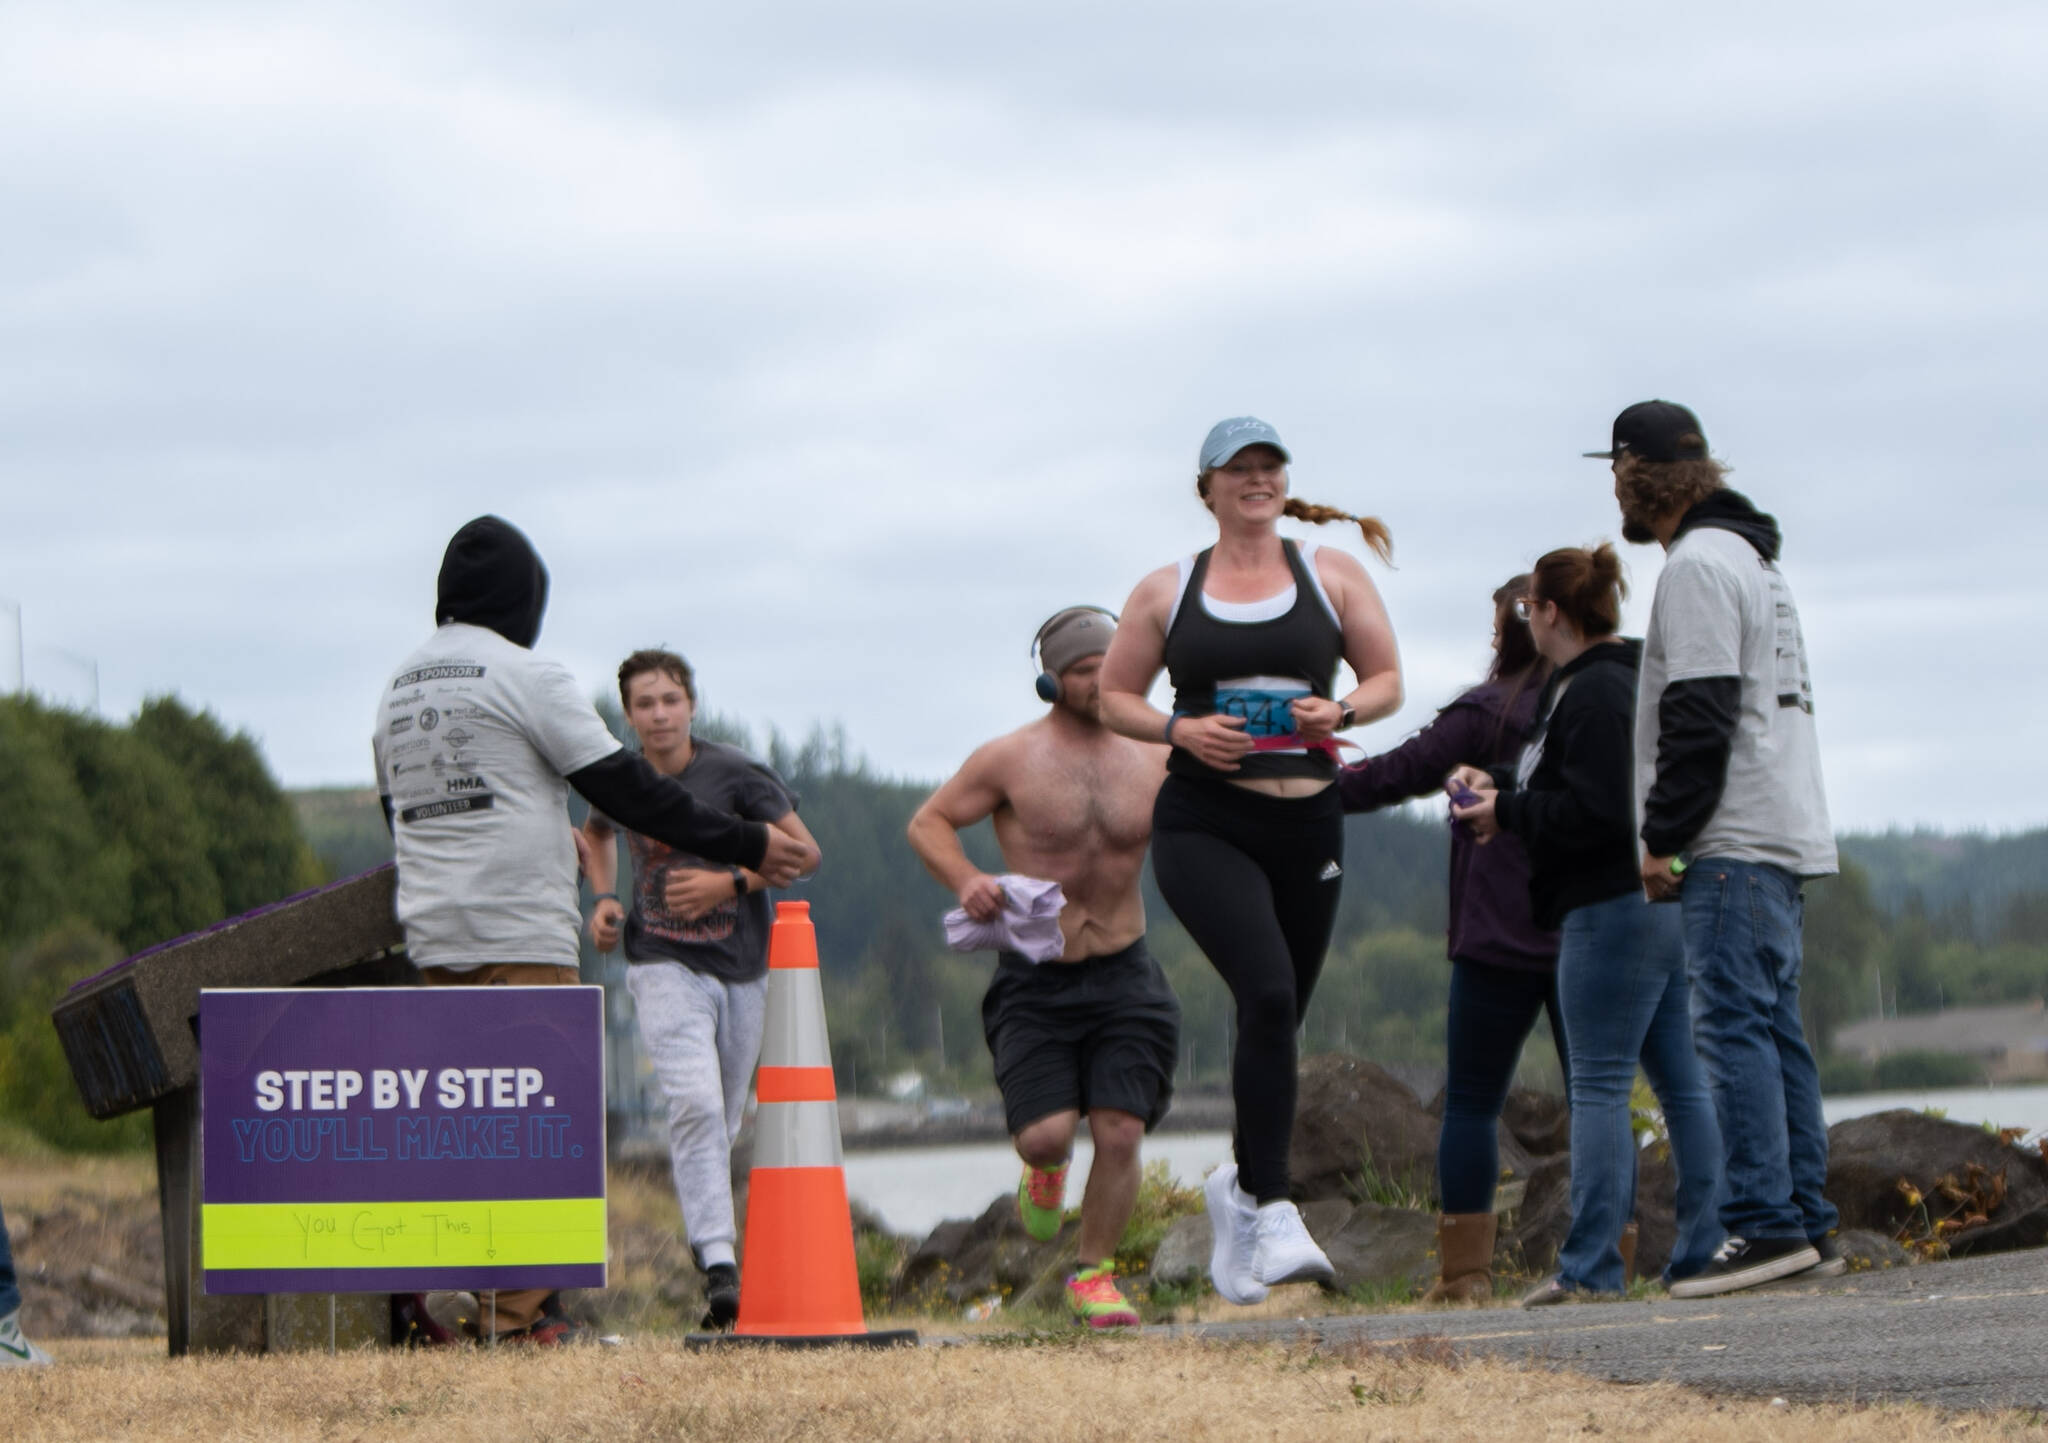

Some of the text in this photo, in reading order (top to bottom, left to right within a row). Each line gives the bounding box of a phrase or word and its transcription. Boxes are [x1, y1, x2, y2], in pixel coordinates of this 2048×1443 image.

[398, 667, 482, 688] 2025 SPONSORS
[446, 776, 487, 792] HMA
[415, 799, 472, 820] VOLUNTEER
[256, 1067, 556, 1111] STEP BY STEP.
[231, 1113, 585, 1162] YOU'LL MAKE IT.
[292, 1210, 337, 1260] You
[351, 1210, 407, 1253] Got
